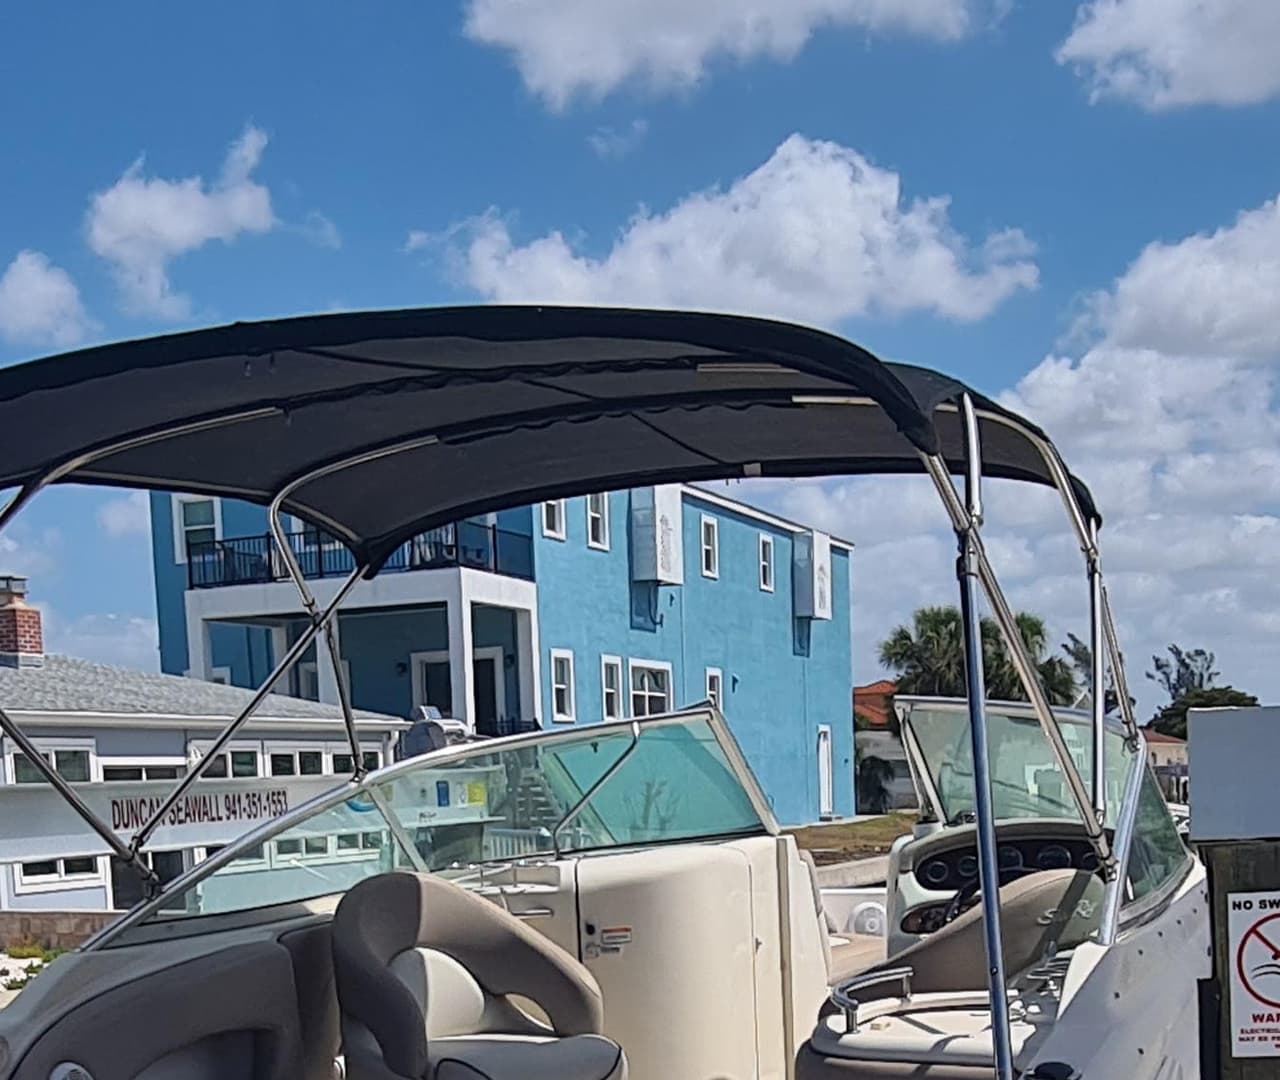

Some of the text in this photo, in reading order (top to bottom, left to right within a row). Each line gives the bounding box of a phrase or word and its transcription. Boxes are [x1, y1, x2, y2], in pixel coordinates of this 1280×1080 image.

[169, 794, 222, 825] SEAWALL
[224, 790, 289, 820] 941-351-1553
[1232, 901, 1254, 910] NO
